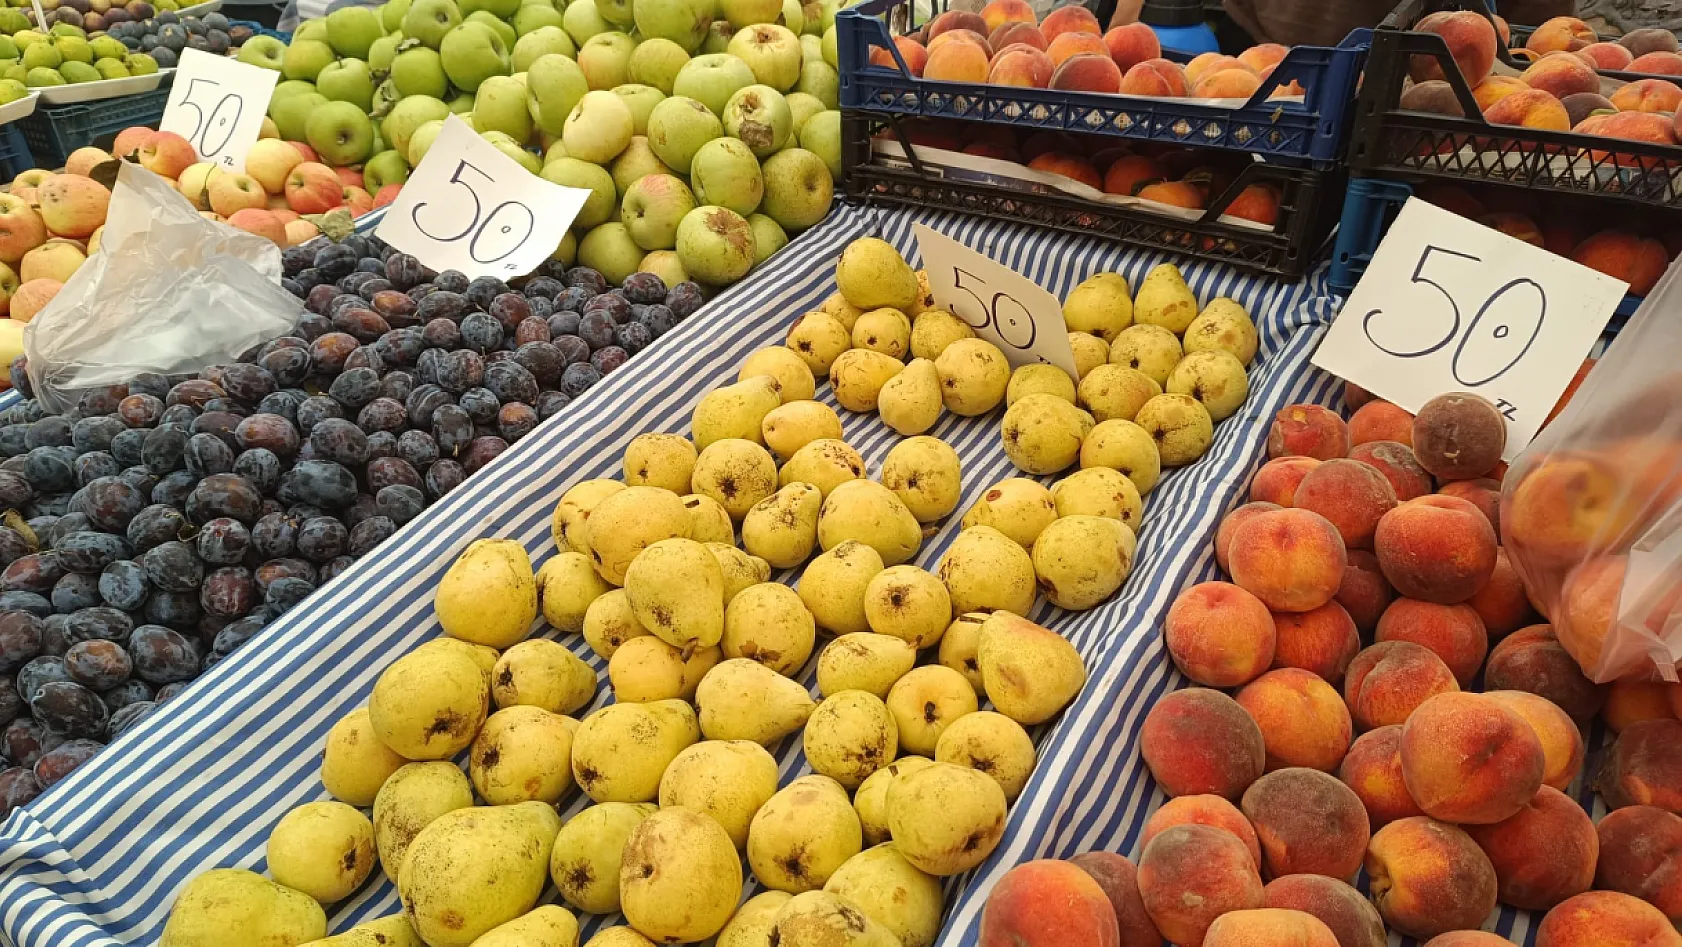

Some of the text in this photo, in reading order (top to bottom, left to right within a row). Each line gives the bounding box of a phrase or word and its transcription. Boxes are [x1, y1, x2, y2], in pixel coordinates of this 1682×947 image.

[178, 78, 243, 157] 50
[411, 159, 534, 264] 50
[949, 266, 1036, 350] 50
[1362, 245, 1547, 387] 50
[1496, 398, 1518, 422] TL
